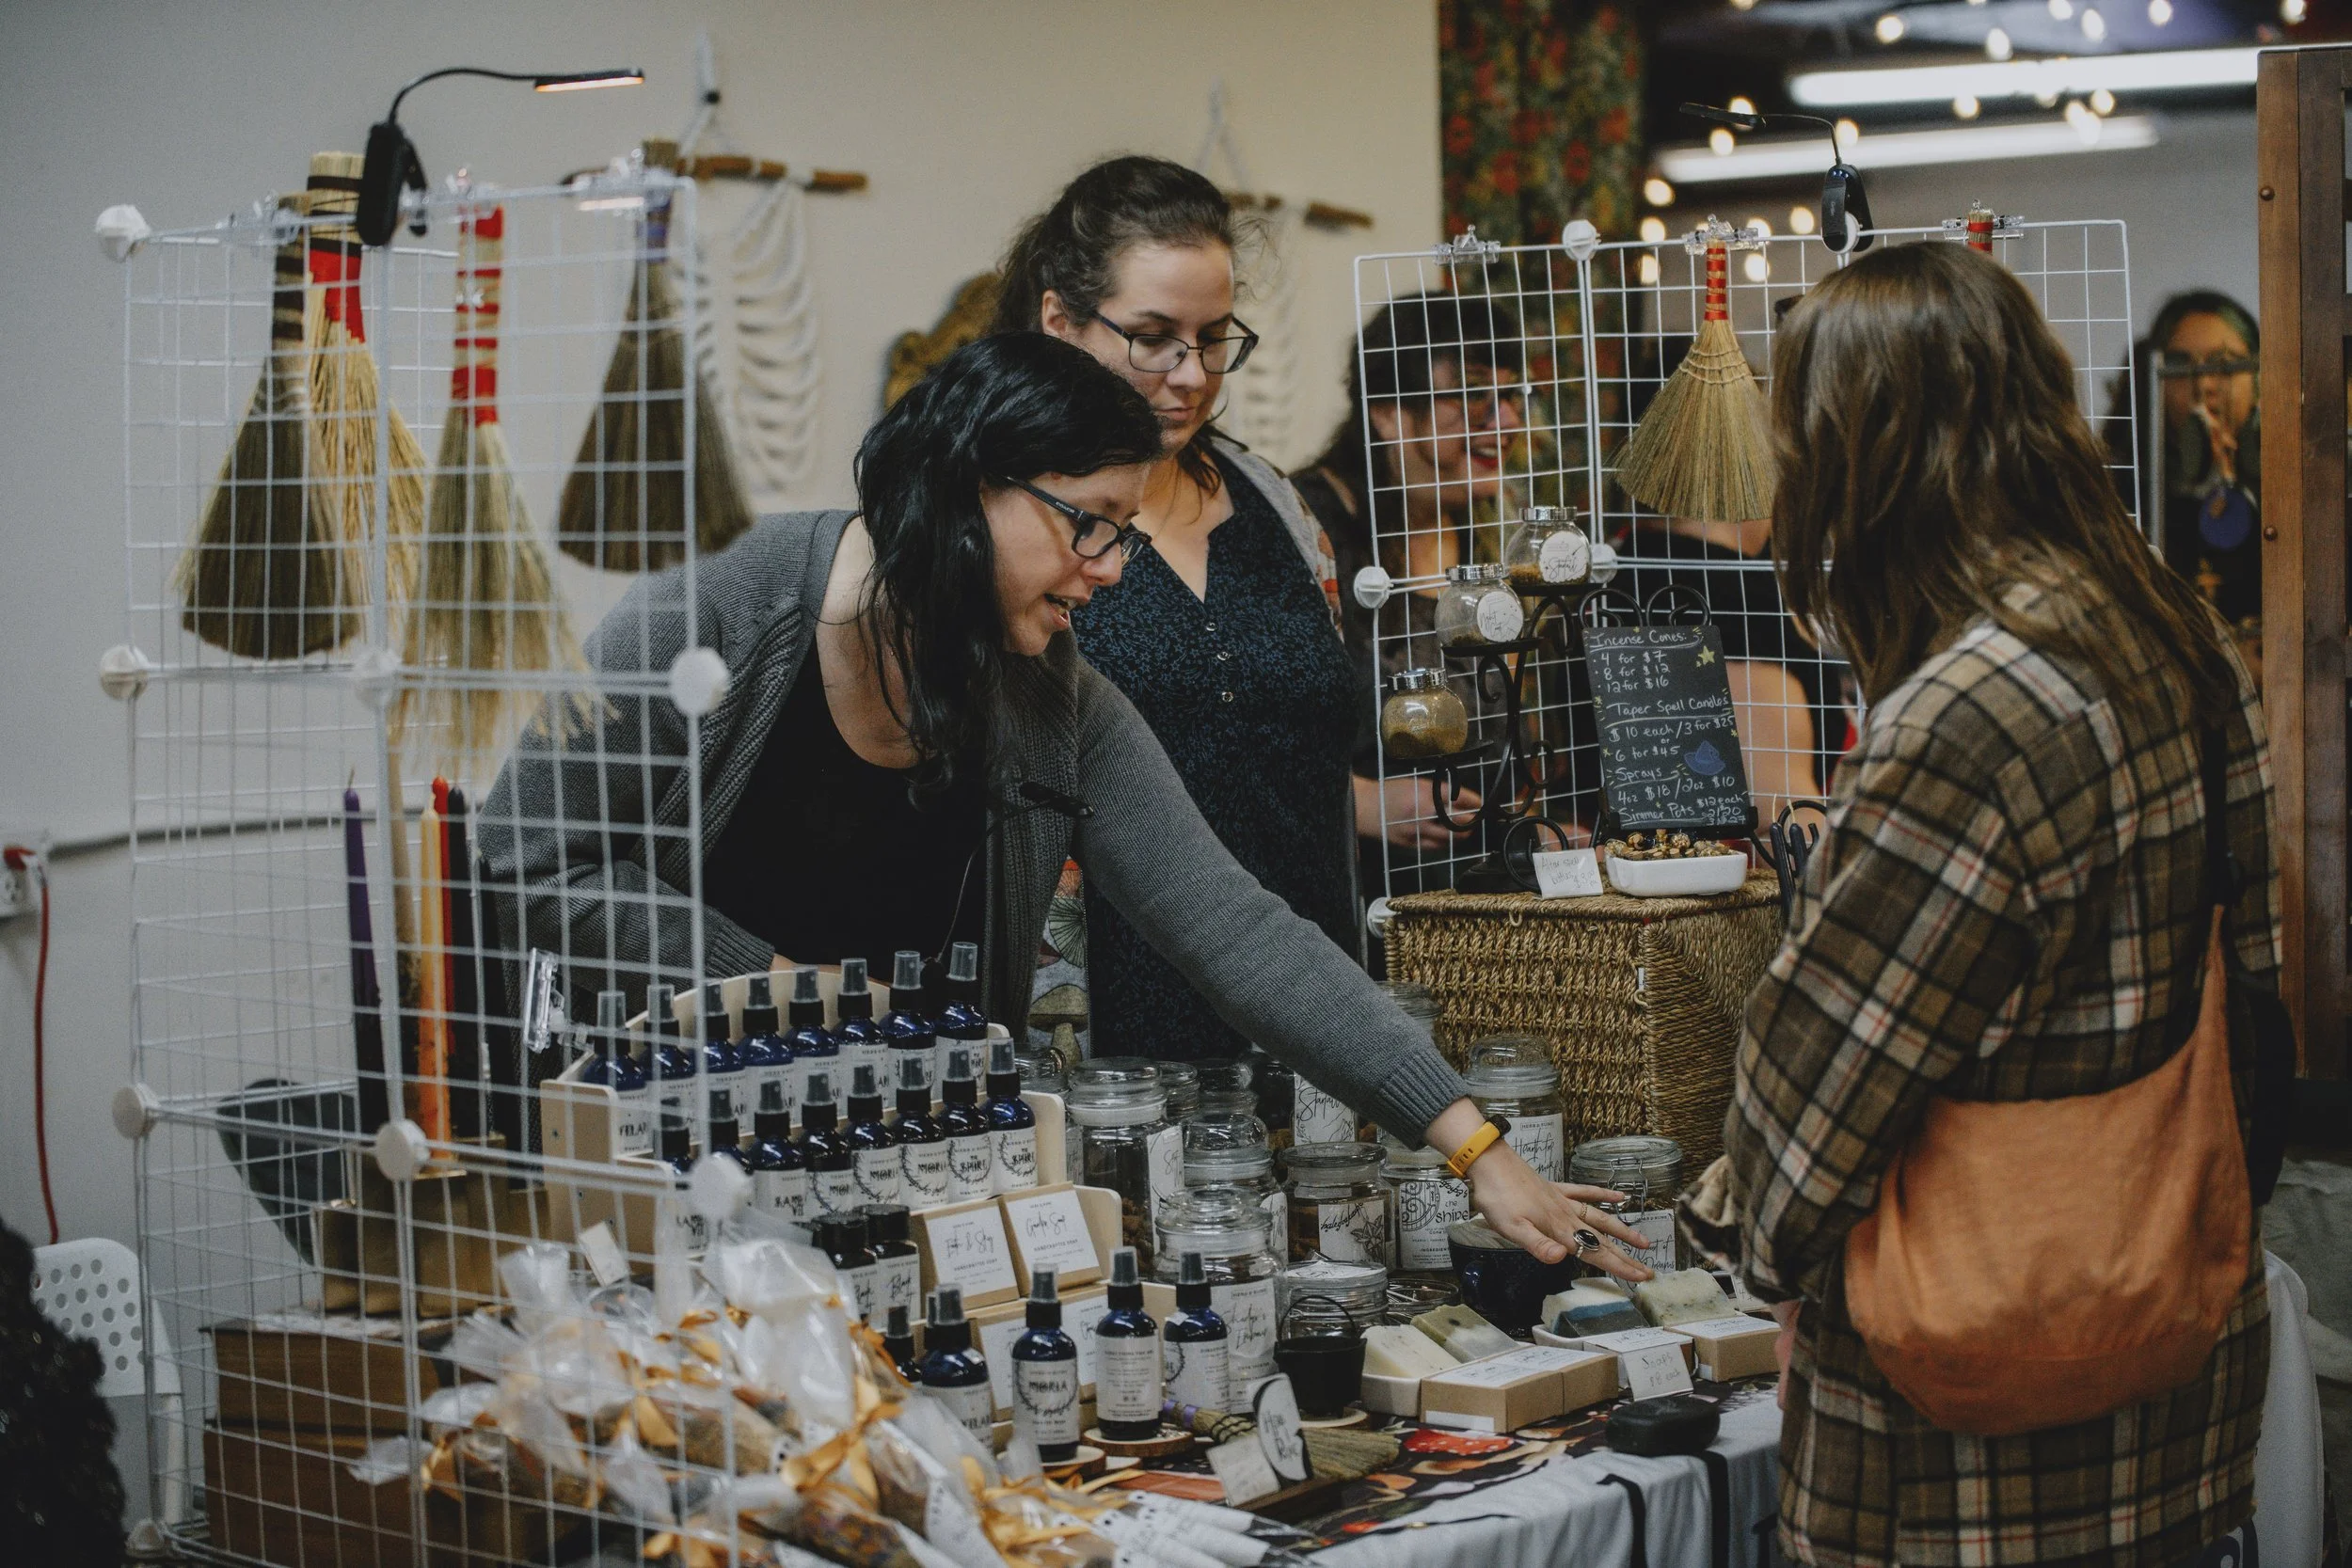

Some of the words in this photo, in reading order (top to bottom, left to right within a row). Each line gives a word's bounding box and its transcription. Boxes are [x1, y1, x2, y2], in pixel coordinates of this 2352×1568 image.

[1589, 632, 1645, 648] Incense
[1648, 629, 1688, 644] Cones:
[1600, 652, 1610, 666] 4
[1618, 653, 1635, 664] for
[1603, 668, 1613, 680] 8
[1619, 666, 1636, 677] for
[1645, 675, 1670, 689] $16
[1606, 702, 1653, 719] Taper
[1657, 699, 1685, 716] Spell
[1689, 693, 1729, 710] Candles
[1643, 724, 1675, 736] each
[1694, 721, 1711, 730] for
[1713, 717, 1734, 729] $25
[1615, 750, 1626, 762] 6
[1632, 746, 1647, 759] for
[1652, 745, 1681, 756] $45
[1614, 767, 1662, 784] Sprays
[1618, 807, 1664, 822] Simmer
[1667, 802, 1695, 818] Pots
